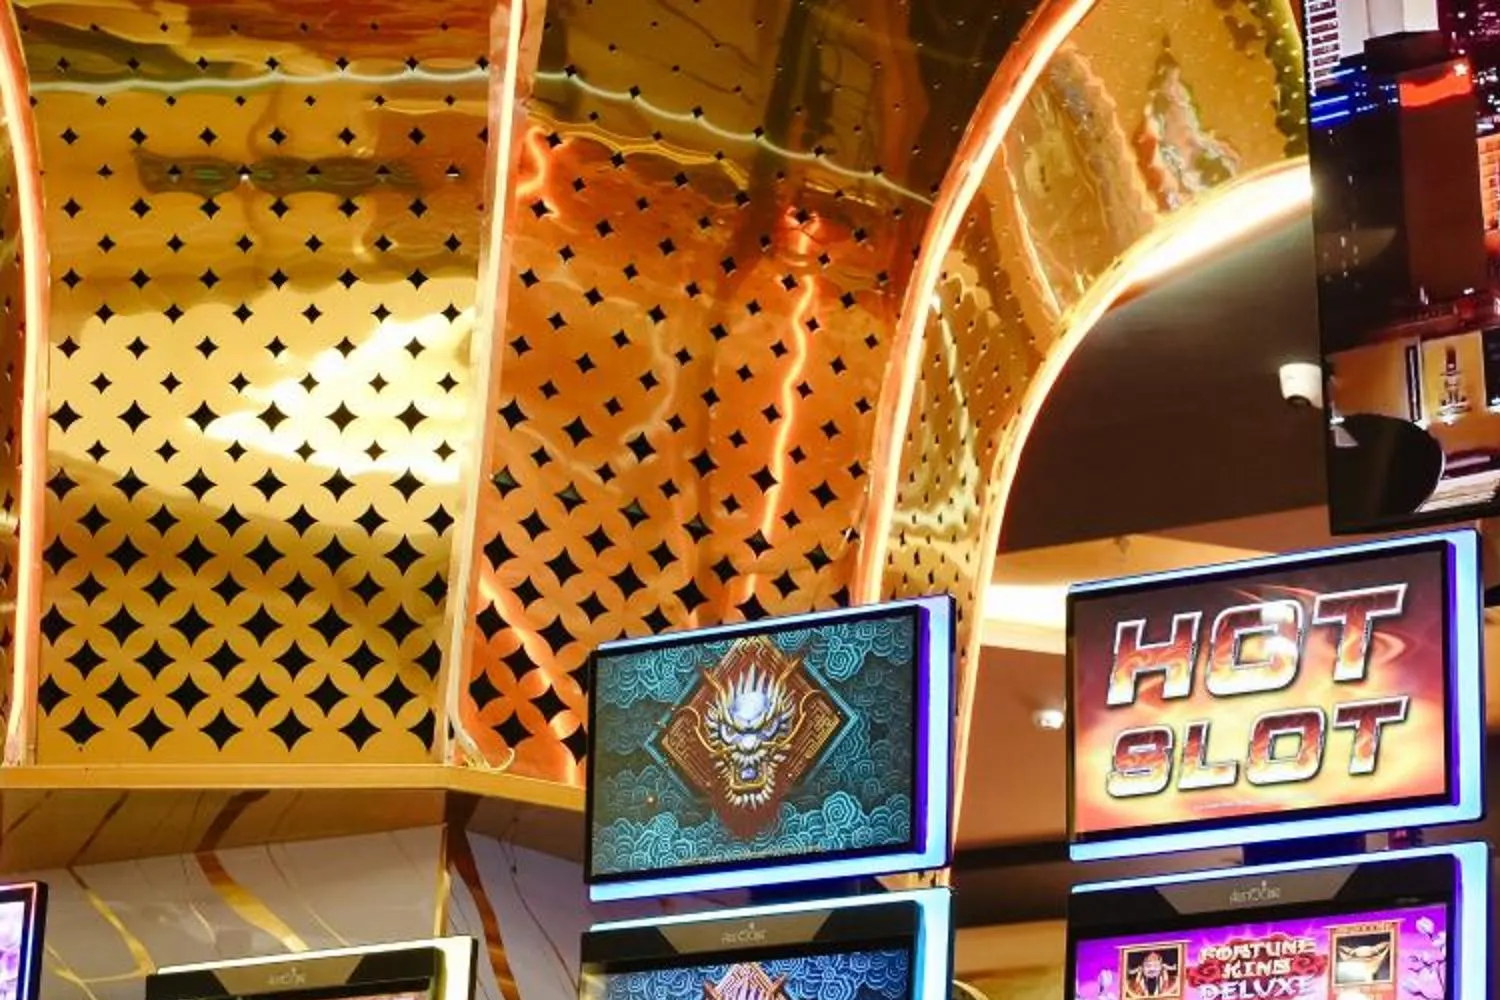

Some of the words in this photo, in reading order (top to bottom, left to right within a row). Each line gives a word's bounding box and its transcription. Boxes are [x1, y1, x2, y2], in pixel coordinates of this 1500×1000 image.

[1106, 582, 1408, 706] HOT
[1106, 695, 1409, 799] SLOT
[1201, 939, 1317, 964] FORTUNE
